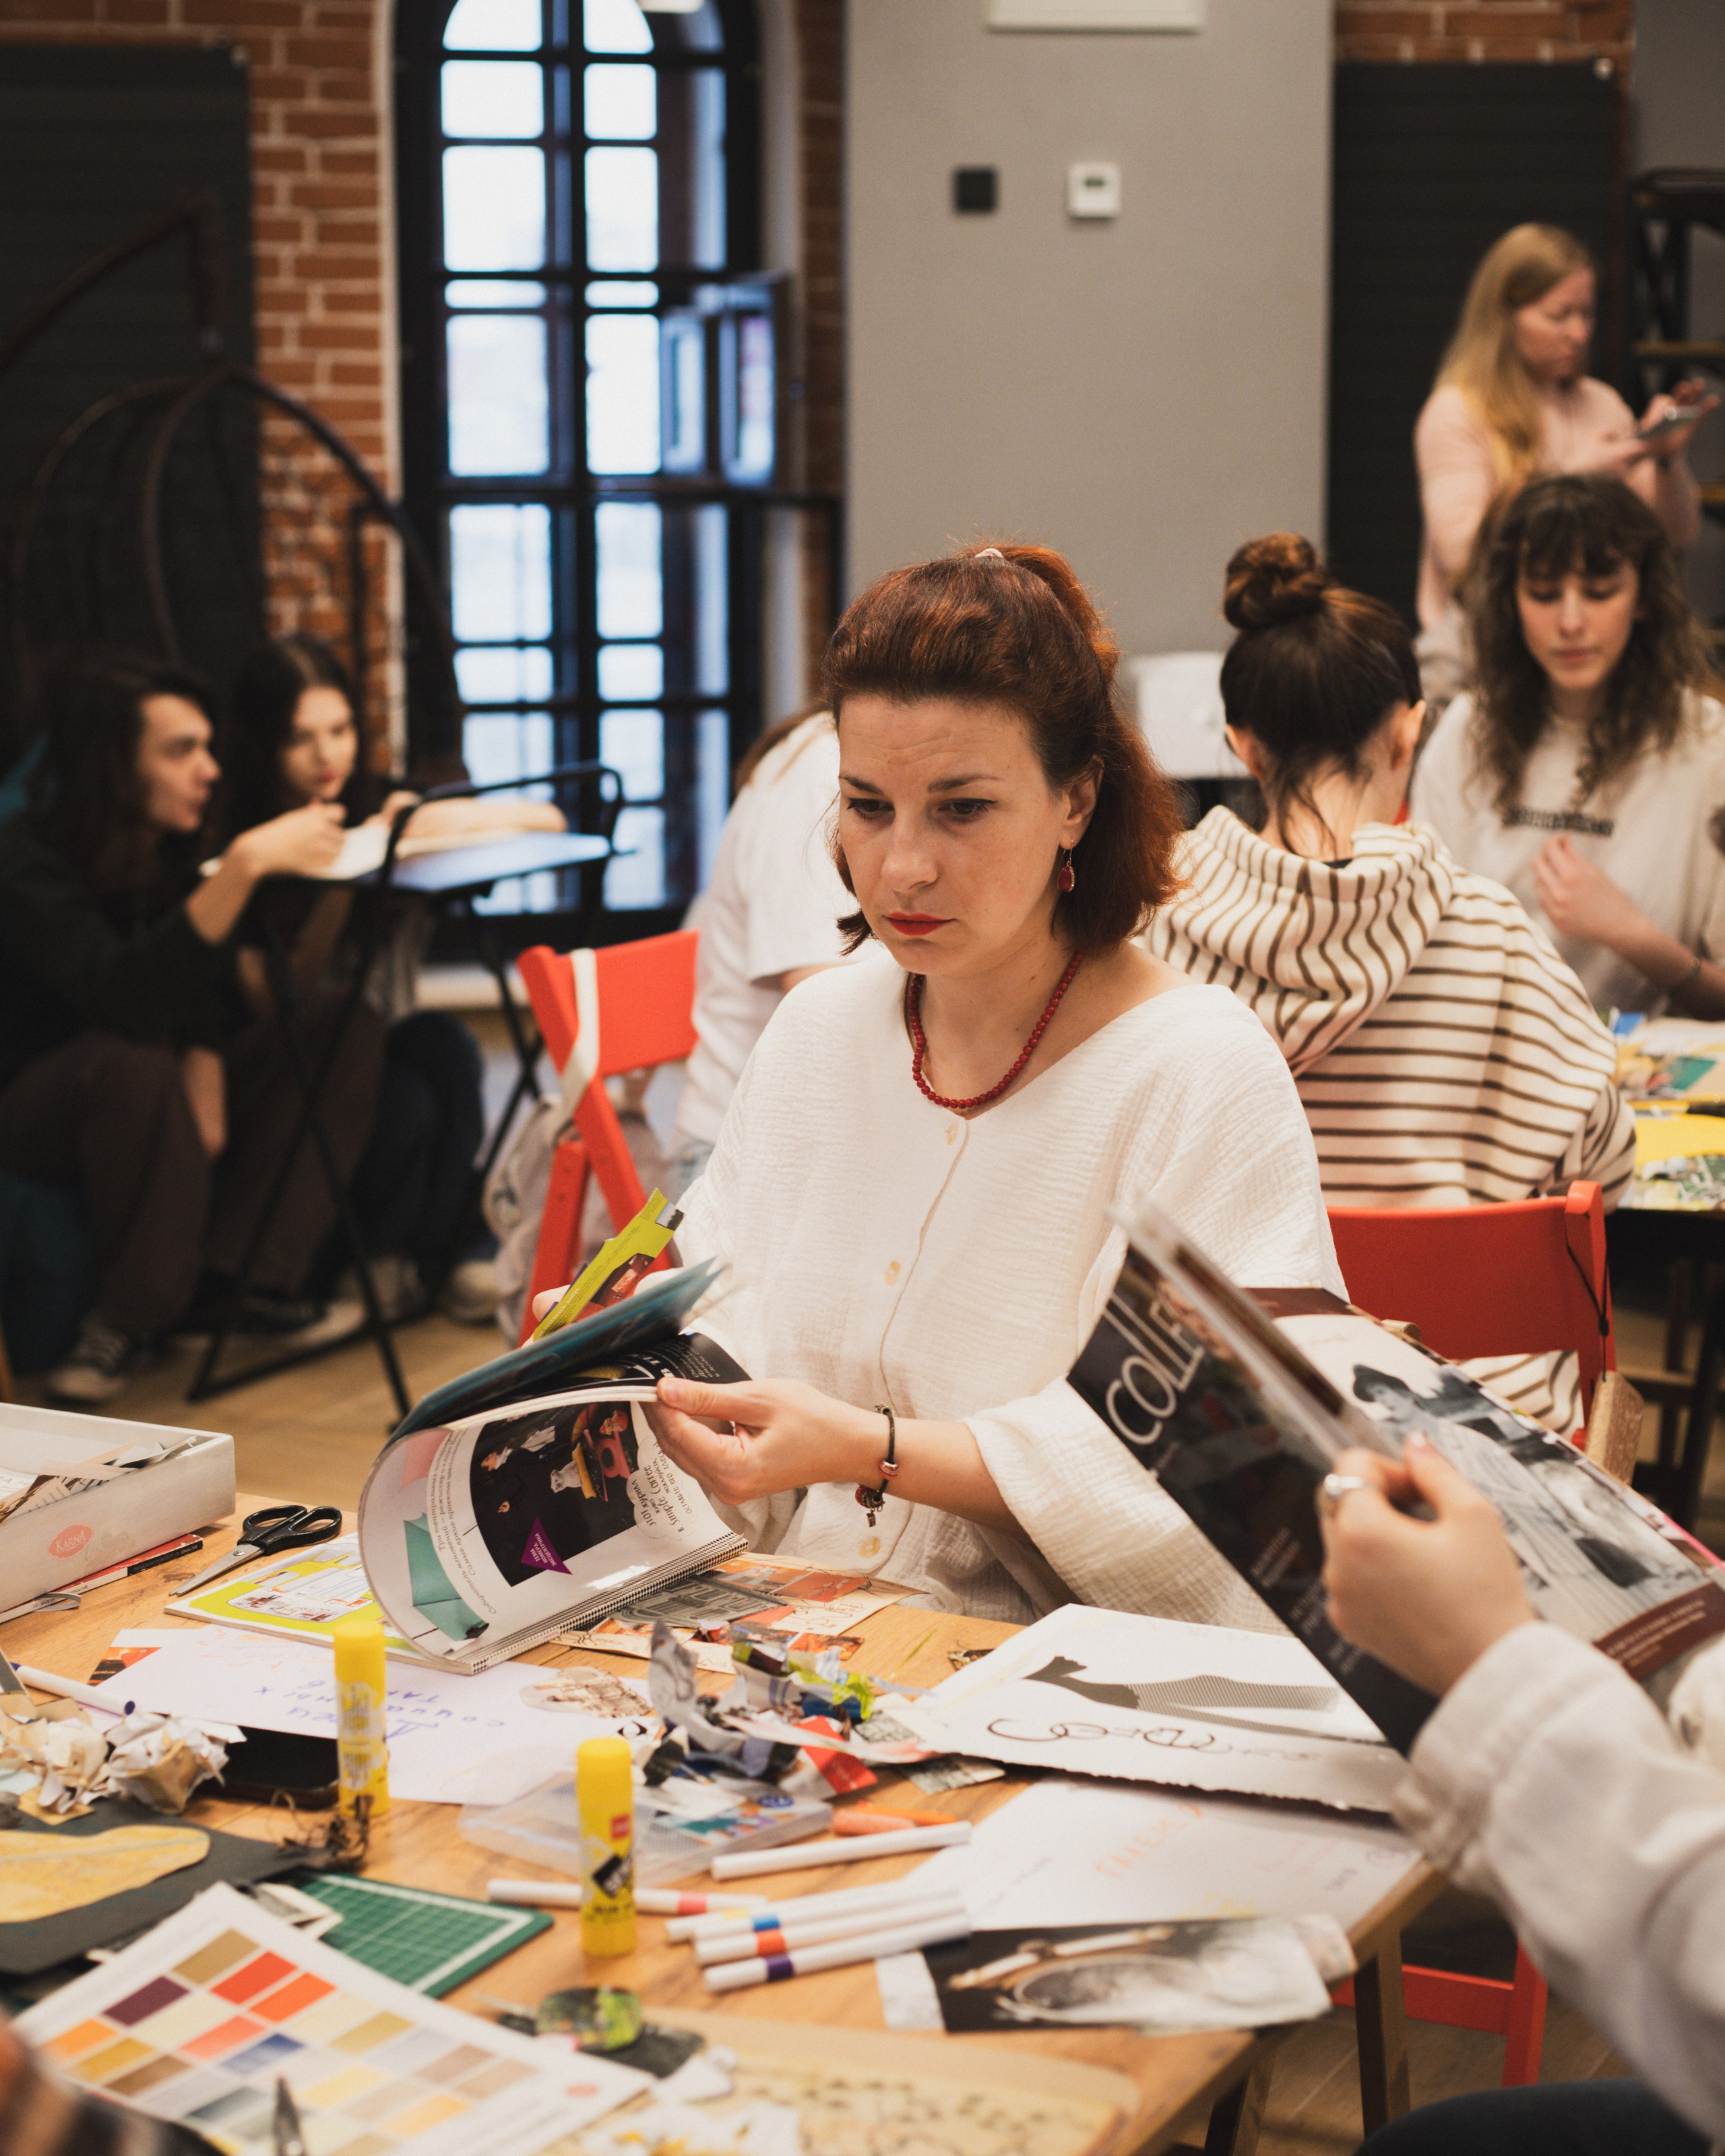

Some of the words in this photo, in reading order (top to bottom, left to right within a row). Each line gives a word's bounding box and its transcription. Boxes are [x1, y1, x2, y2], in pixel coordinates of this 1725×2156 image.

[446, 1482, 454, 1519] проекты
[658, 1496, 680, 1525] Simple
[56, 1529, 86, 1552] KARNA
[437, 1535, 445, 1551] Три
[442, 1526, 462, 1568] мгновений
[451, 1521, 462, 1546] яркие
[460, 1548, 476, 1576] Самые
[530, 1548, 540, 1562] ТЕМА
[462, 1571, 497, 1614] Собиратель
